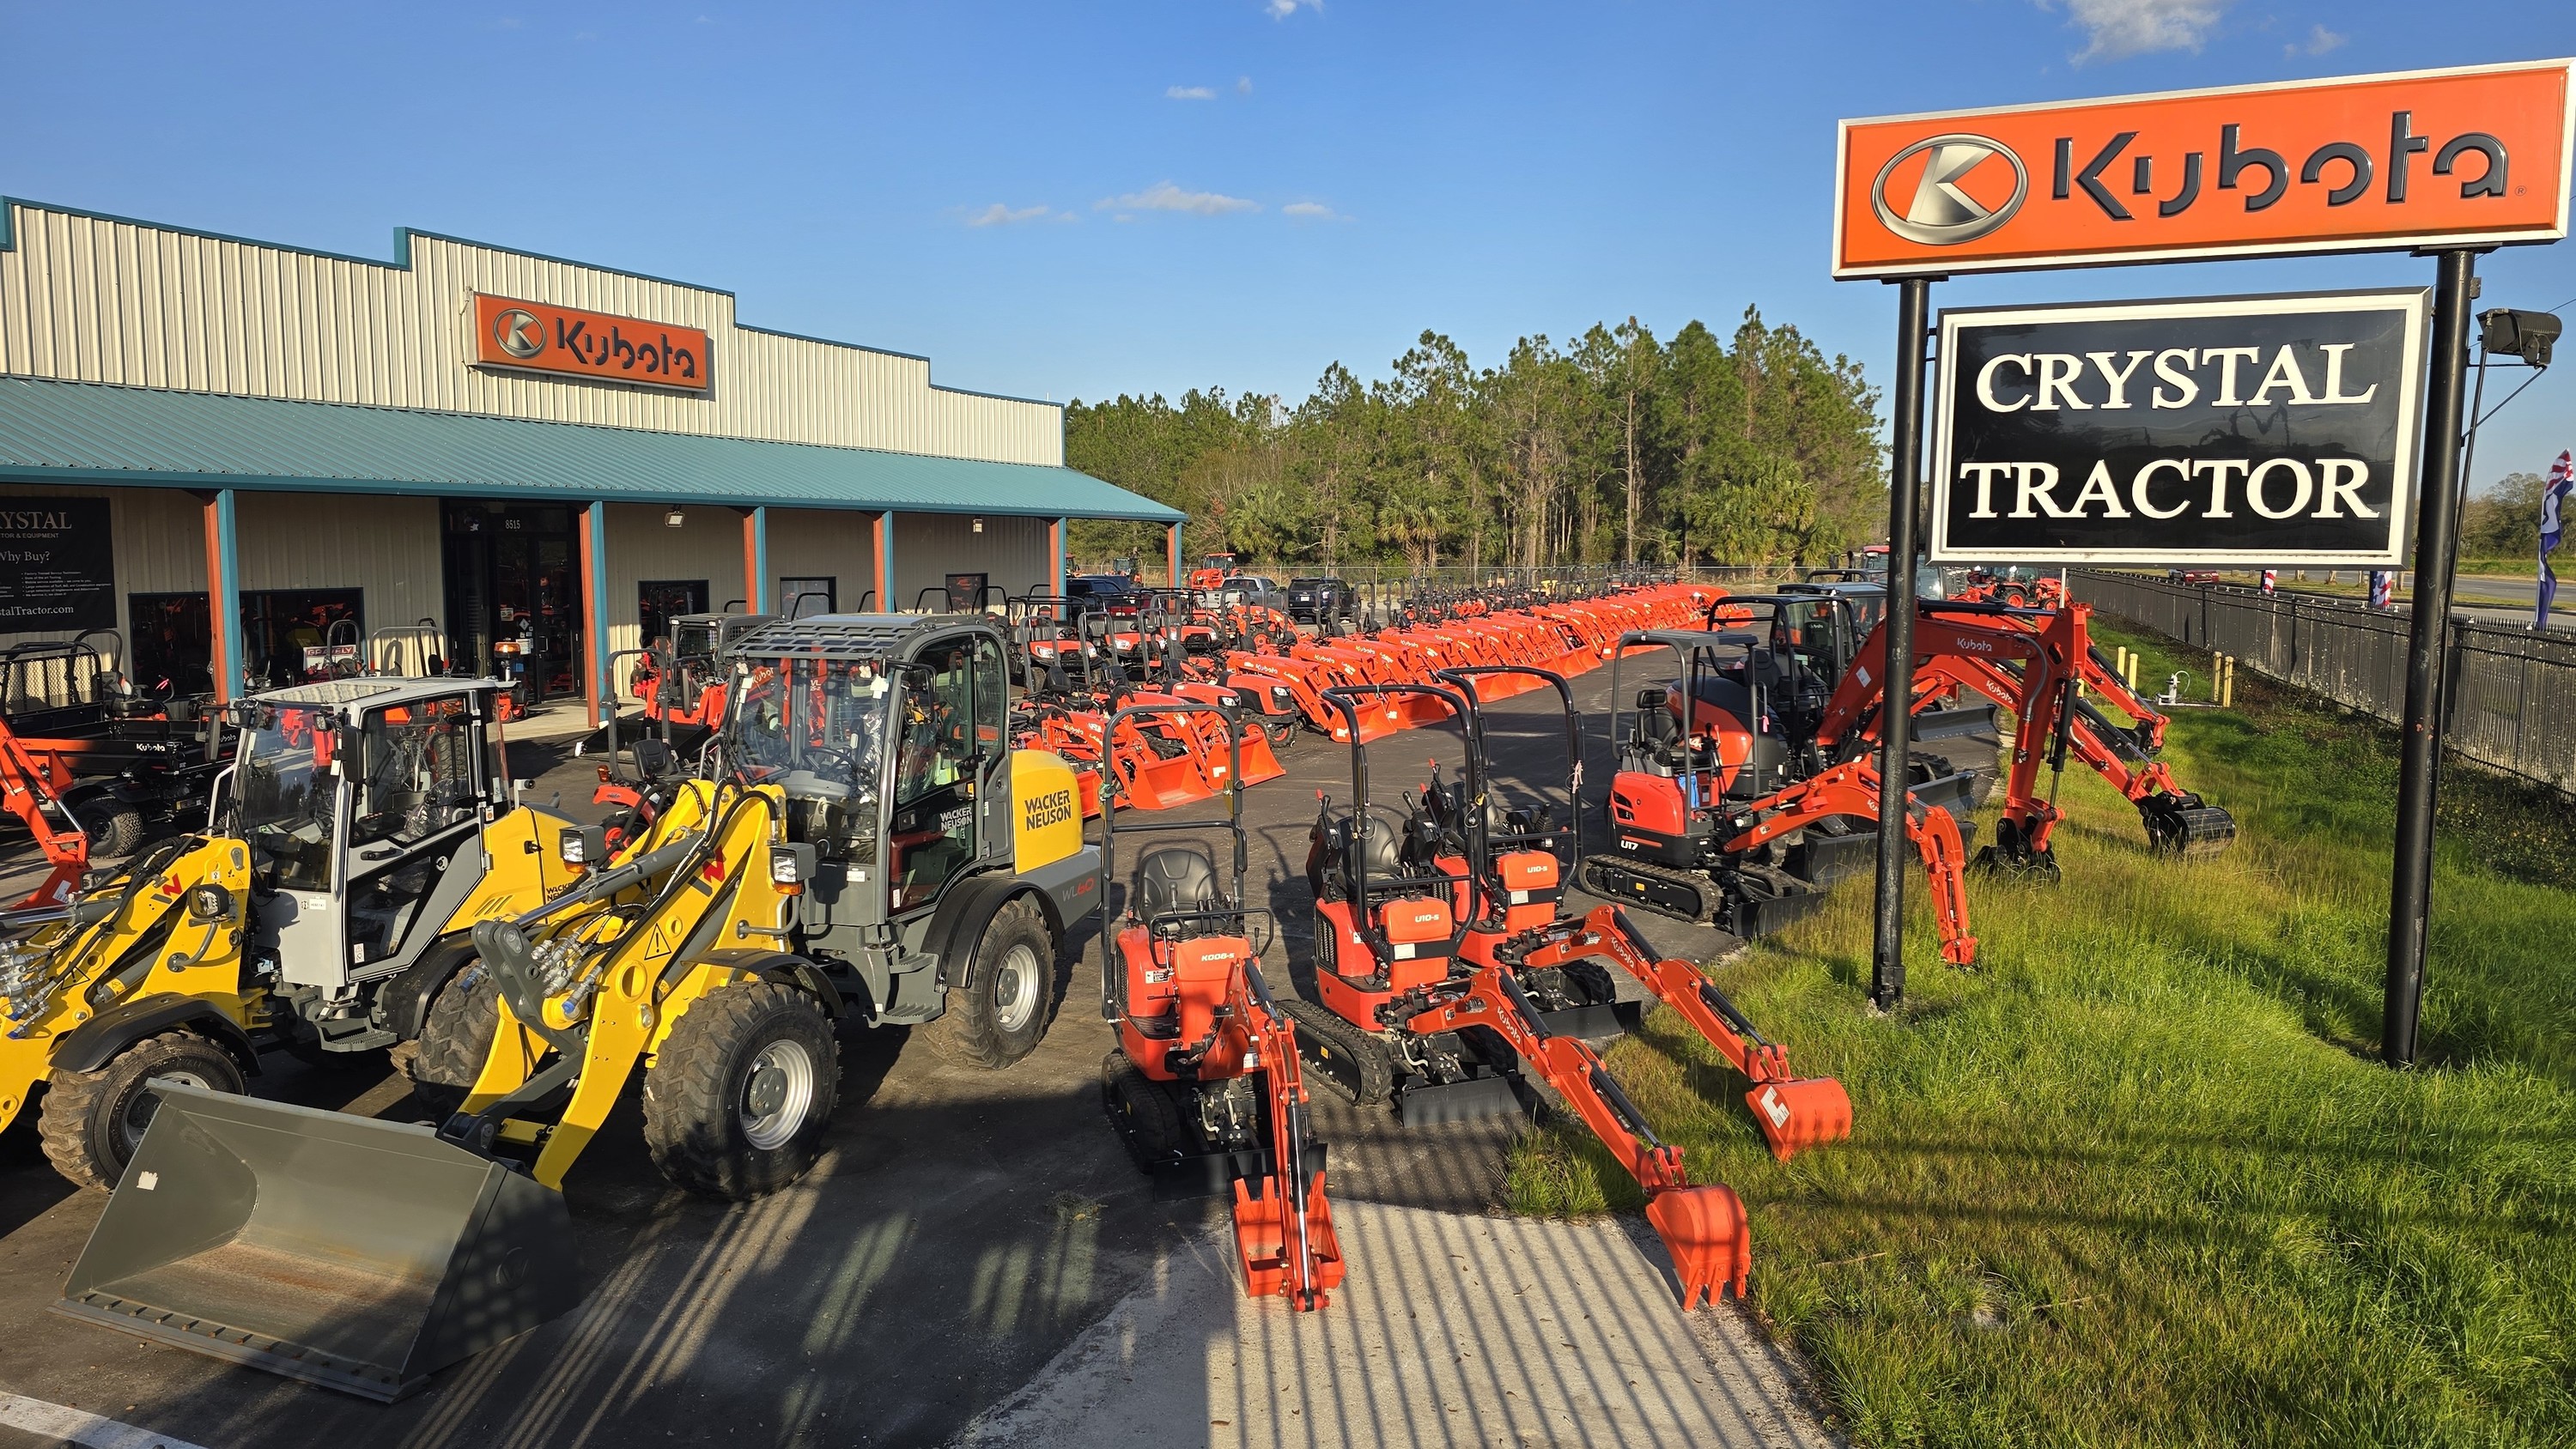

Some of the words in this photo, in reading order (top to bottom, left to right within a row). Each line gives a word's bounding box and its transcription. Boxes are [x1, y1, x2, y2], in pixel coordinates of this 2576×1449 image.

[2052, 111, 2508, 221] Kubota
[556, 317, 696, 379] Kubota
[1976, 343, 2378, 413] CRYSTAL
[1959, 457, 2380, 521] TRACTOR
[0, 511, 72, 530] YSTAL
[505, 519, 521, 530] 8515
[24, 550, 51, 564] Buy?
[0, 606, 74, 616] talTractor.com
[1957, 637, 1992, 652] Kubota
[752, 667, 774, 684] Kubot
[1985, 679, 2014, 705] Kubota
[219, 733, 236, 743] ubota
[1063, 724, 1084, 736] Kubota
[136, 743, 166, 752] Kubota
[1024, 789, 1071, 815] WACKER
[939, 807, 973, 821] WACKER
[1025, 804, 1072, 831] NEUSON
[940, 817, 973, 832] NEUSON
[1620, 840, 1639, 851] U17
[546, 882, 573, 894] WACK
[1061, 877, 1096, 902] WL60
[1611, 937, 1635, 969] Kubota
[1497, 1005, 1522, 1045] Kubota
